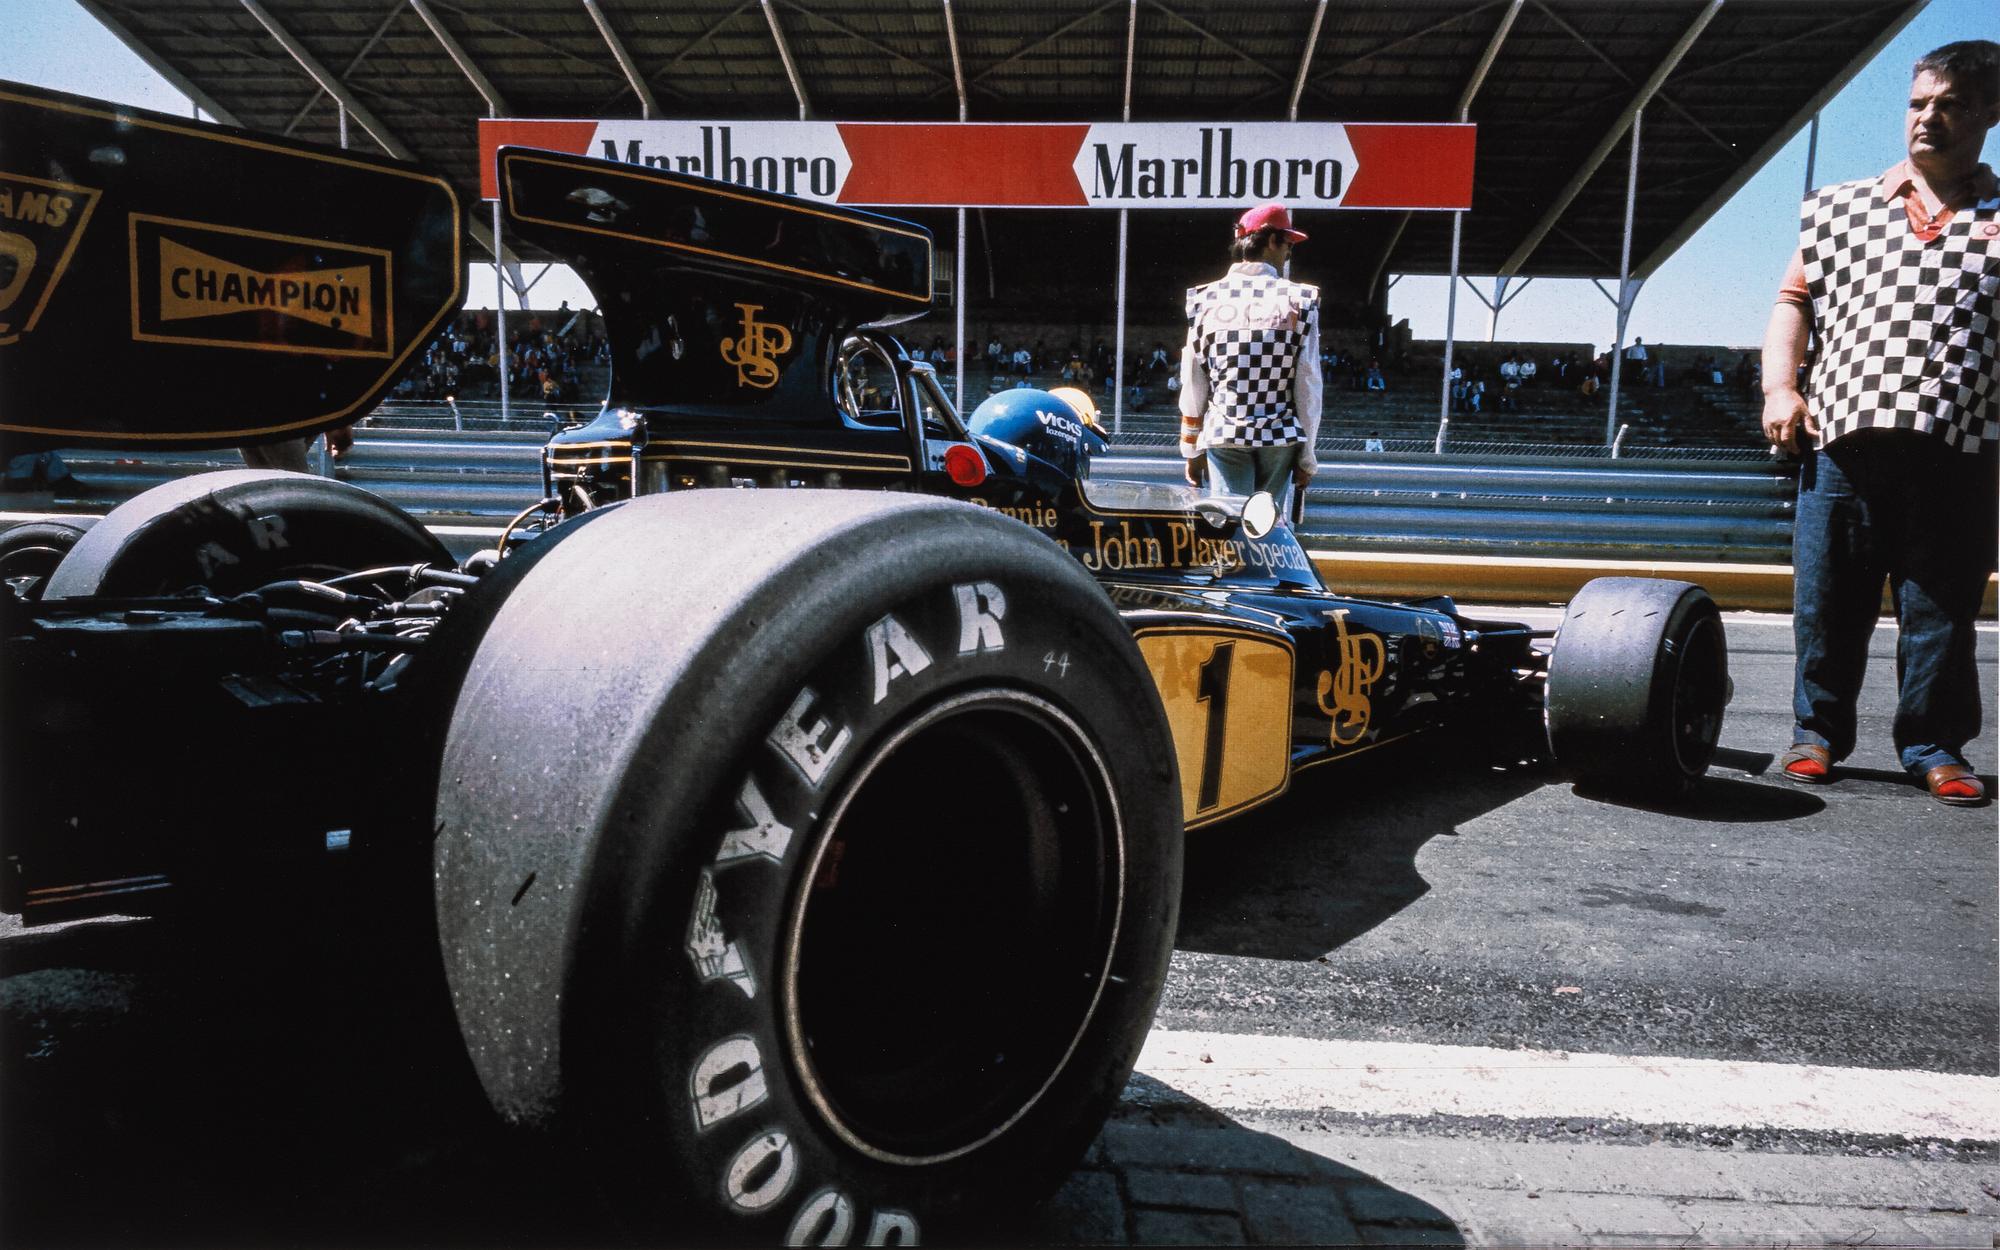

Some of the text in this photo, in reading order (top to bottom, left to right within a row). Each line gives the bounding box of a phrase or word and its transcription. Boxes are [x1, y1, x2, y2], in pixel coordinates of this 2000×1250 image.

[1091, 128, 1343, 200] Marlboro
[171, 266, 360, 317] CHAMPION
[1036, 410, 1082, 437] VICKS
[970, 498, 1058, 528] nnie
[1083, 521, 1165, 571] John
[1168, 522, 1247, 578] Player
[1043, 650, 1071, 678] 44
[1197, 641, 1236, 814] 1
